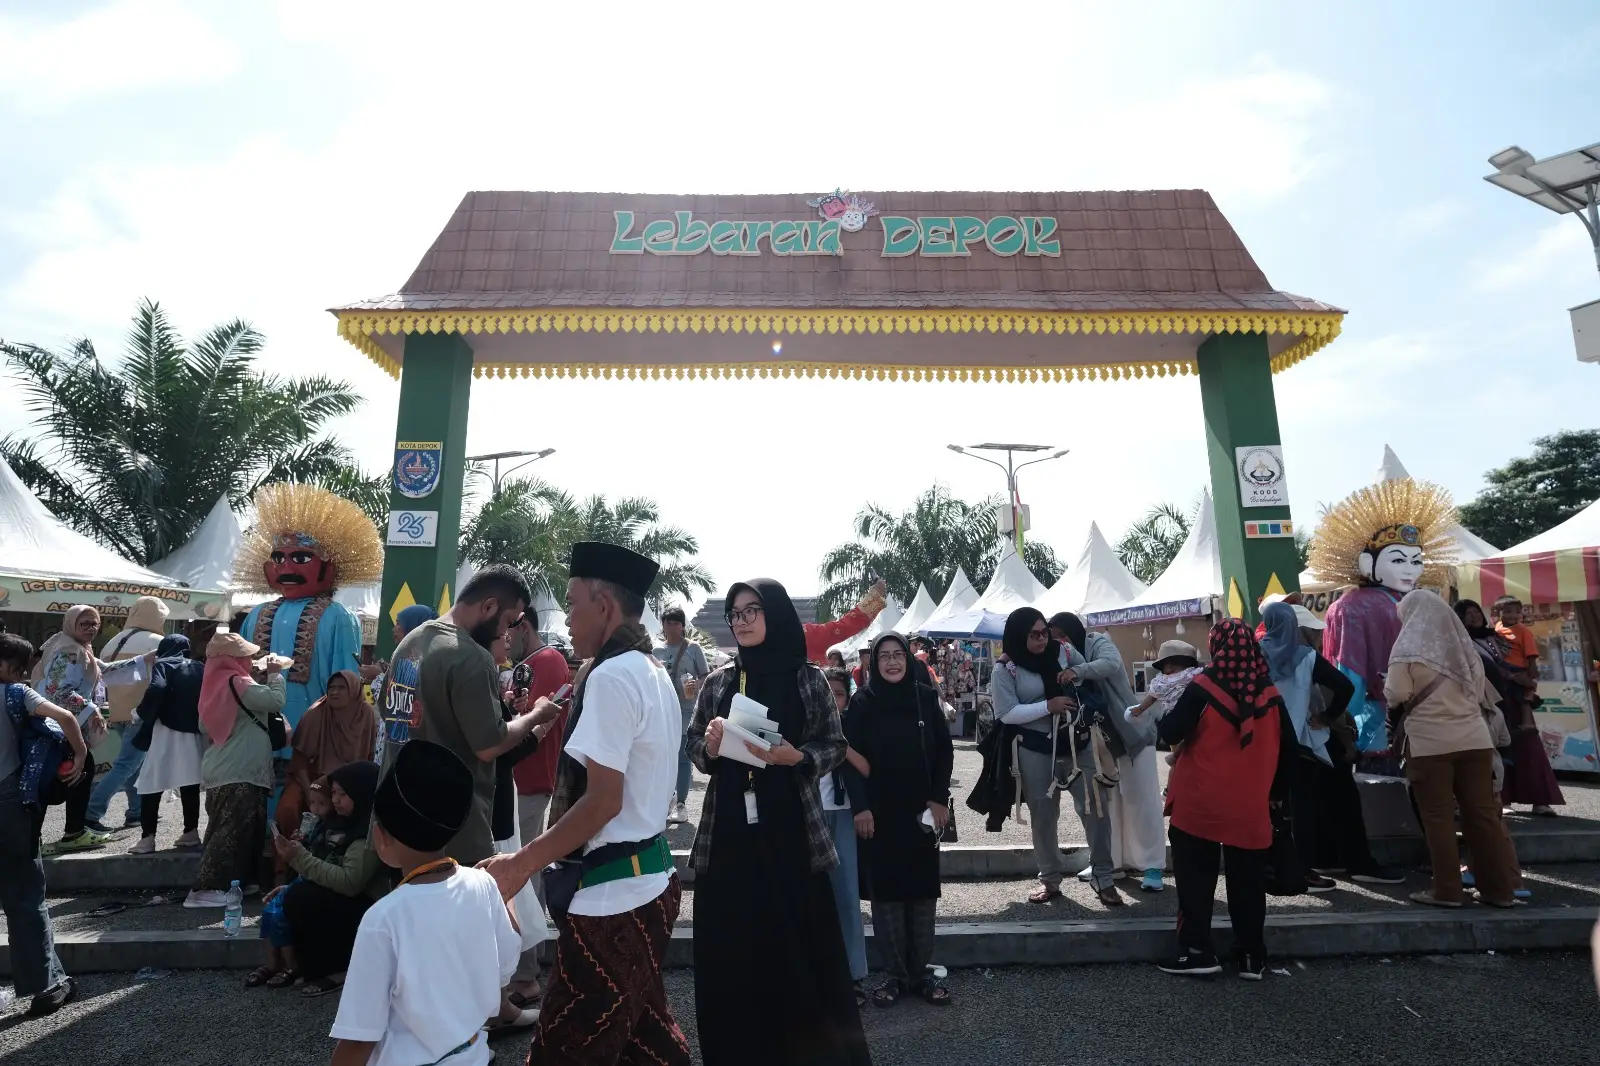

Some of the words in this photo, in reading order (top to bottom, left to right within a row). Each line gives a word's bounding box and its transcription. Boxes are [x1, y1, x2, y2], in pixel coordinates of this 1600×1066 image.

[609, 210, 844, 257] Lebaran
[880, 216, 1061, 259] DEPOK
[397, 512, 426, 539] 26
[22, 581, 57, 593] ICE
[57, 581, 126, 593] CREAM
[127, 583, 190, 604] DURIAN
